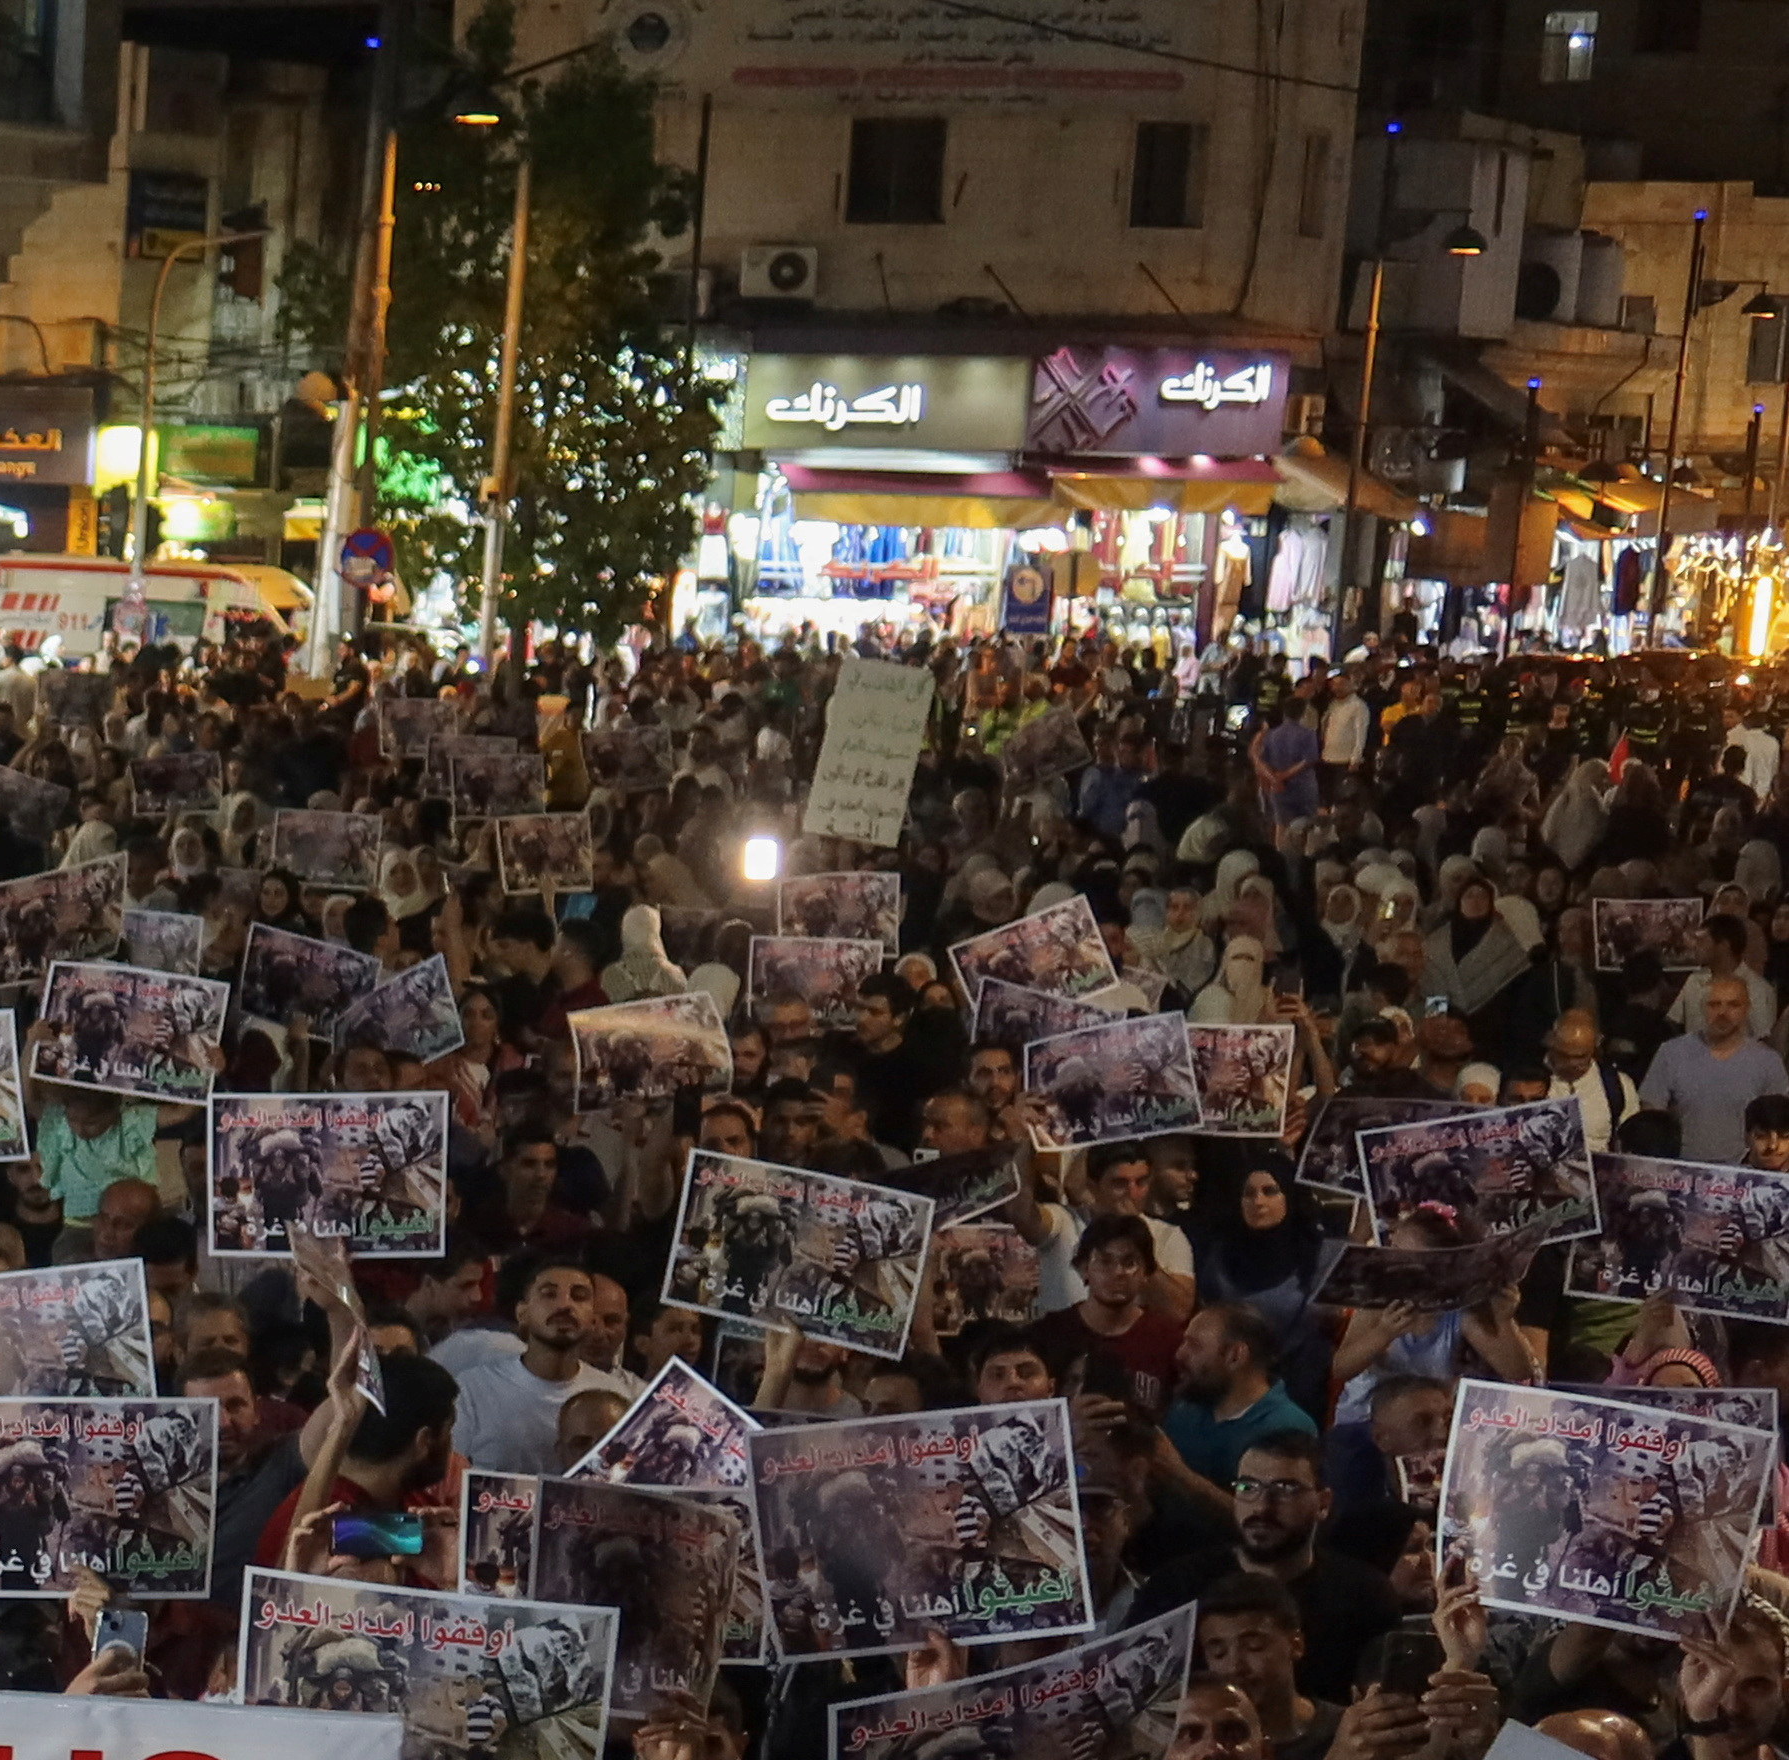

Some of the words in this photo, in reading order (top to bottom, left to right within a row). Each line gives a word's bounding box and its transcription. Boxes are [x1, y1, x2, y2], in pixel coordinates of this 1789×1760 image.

[1159, 361, 1272, 410] الكرنك
[765, 382, 923, 431] الكرنك
[58, 612, 89, 631] 911
[1463, 1404, 1528, 1431] العدو
[1535, 1413, 1603, 1448] إمداد
[1606, 1421, 1690, 1464] أوقفوا
[961, 1564, 1076, 1619] أغيثوا
[1558, 1562, 1622, 1598] أهلنا
[254, 1597, 332, 1630] العدو
[339, 1607, 416, 1647] إمداد
[421, 1613, 516, 1659] أوقفوا
